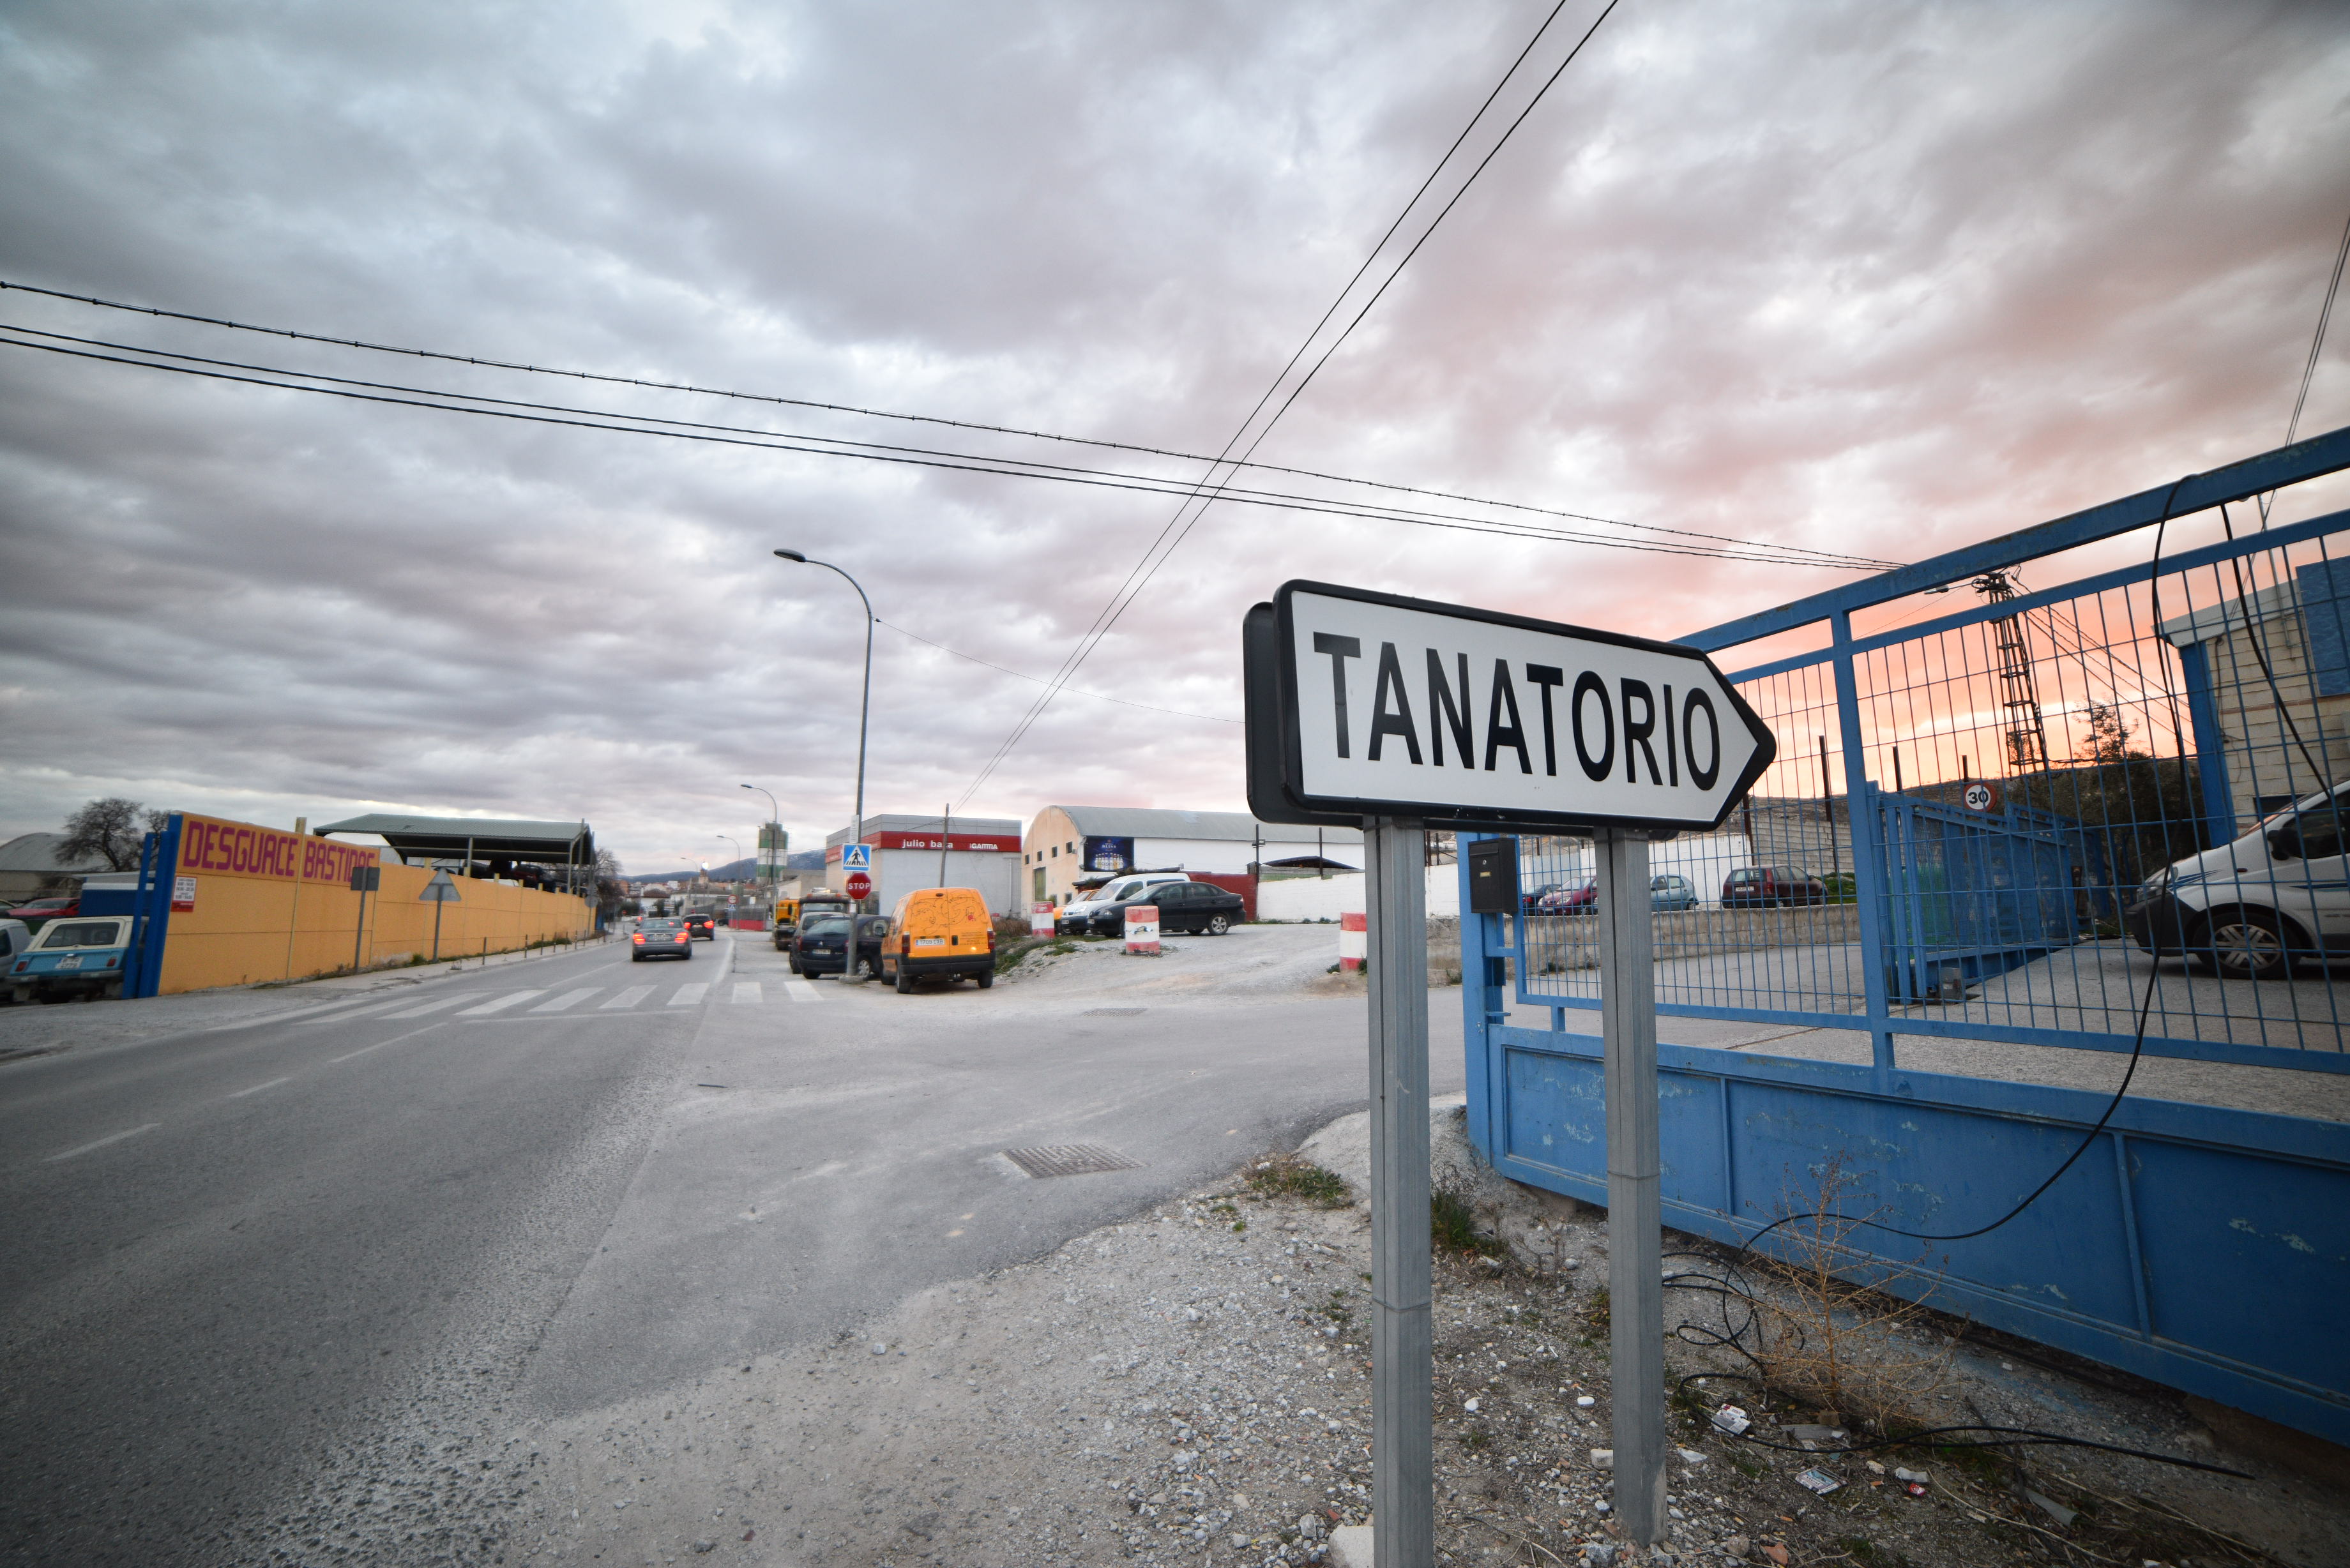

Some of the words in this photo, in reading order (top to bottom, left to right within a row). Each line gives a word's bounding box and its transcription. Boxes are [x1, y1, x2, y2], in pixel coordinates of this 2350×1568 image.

[1313, 631, 1720, 791] TANATORIO
[1968, 791, 1989, 804] 30
[183, 820, 298, 877] DESGUACE
[902, 839, 925, 848] julio
[930, 840, 953, 848] baa
